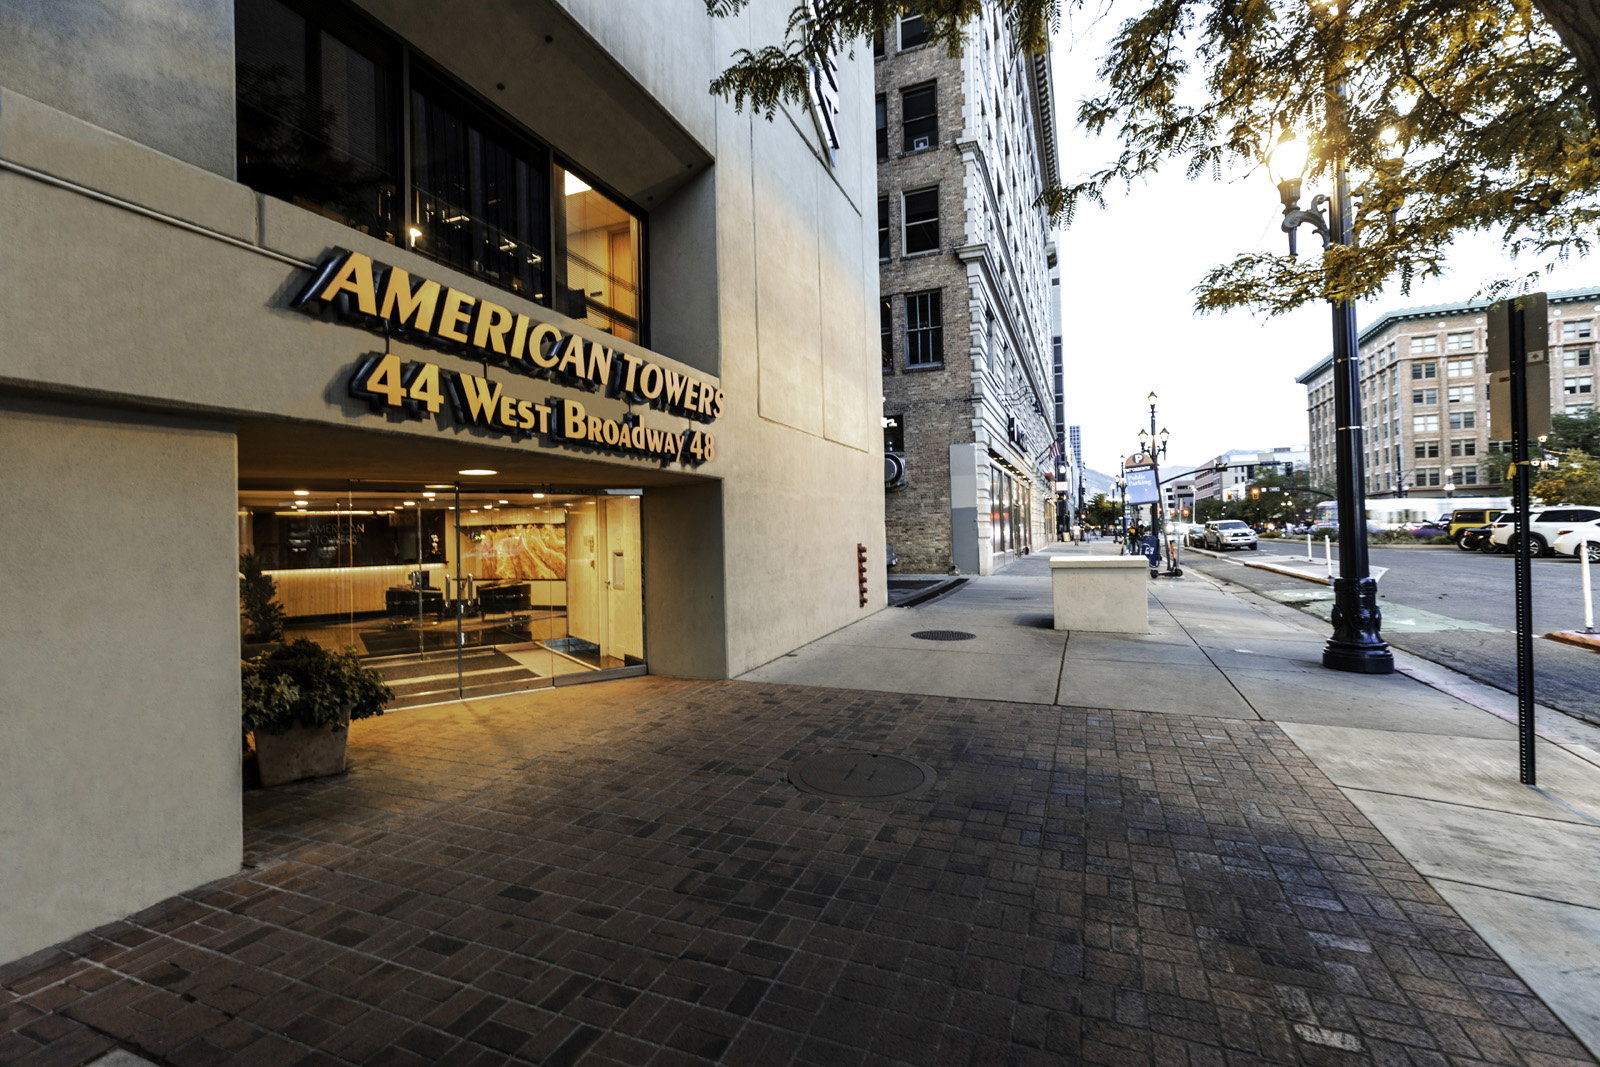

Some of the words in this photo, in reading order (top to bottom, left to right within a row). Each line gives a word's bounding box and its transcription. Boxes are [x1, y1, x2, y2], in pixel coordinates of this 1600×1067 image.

[320, 251, 613, 386] AMERICAN
[623, 352, 726, 420] TOWERS
[366, 353, 445, 413] 44
[459, 373, 552, 434] WEST
[689, 431, 715, 462] 48
[1134, 454, 1143, 464] P
[307, 523, 365, 533] AMERCAN
